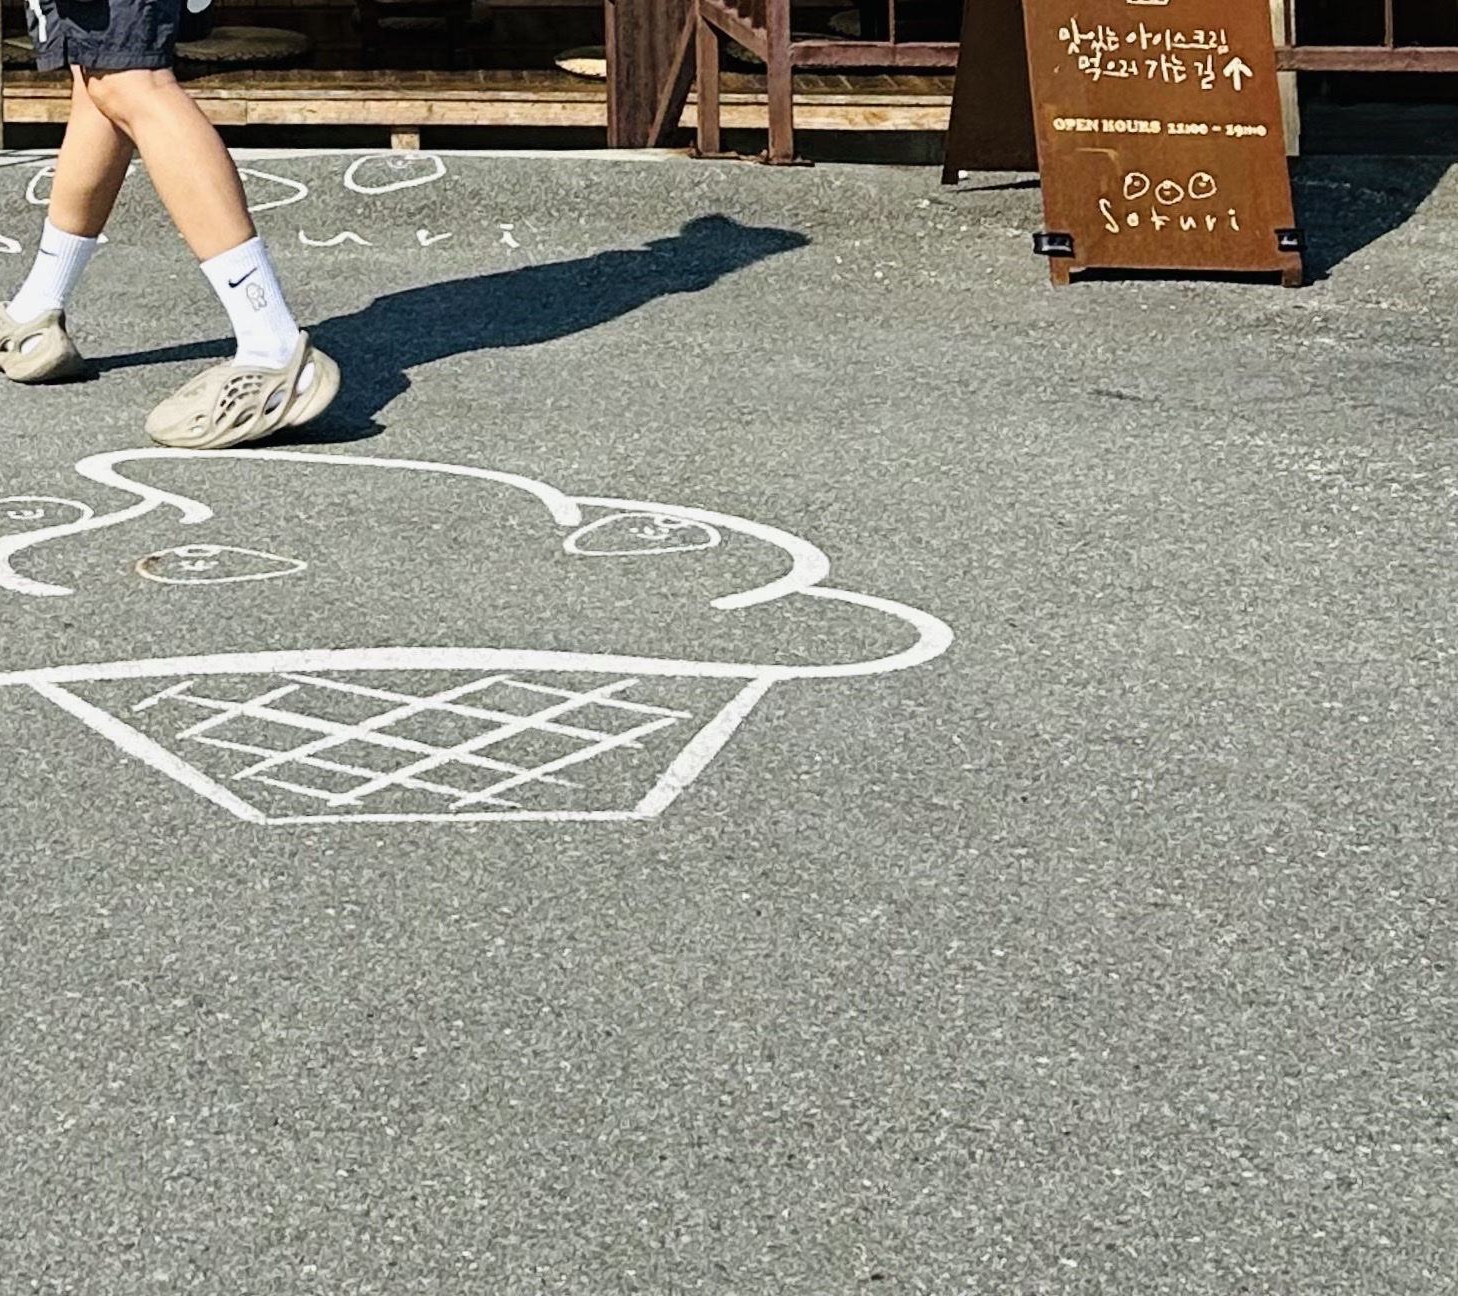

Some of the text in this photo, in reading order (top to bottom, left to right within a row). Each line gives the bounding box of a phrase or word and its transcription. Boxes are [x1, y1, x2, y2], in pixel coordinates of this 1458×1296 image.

[1058, 17, 1230, 55] 맛있는 아이스크림
[1078, 51, 1216, 90] 먹으러 가는 길
[1052, 117, 1099, 132] OPEN
[1101, 119, 1162, 134] HOURS
[1099, 197, 1240, 234] Sokuri
